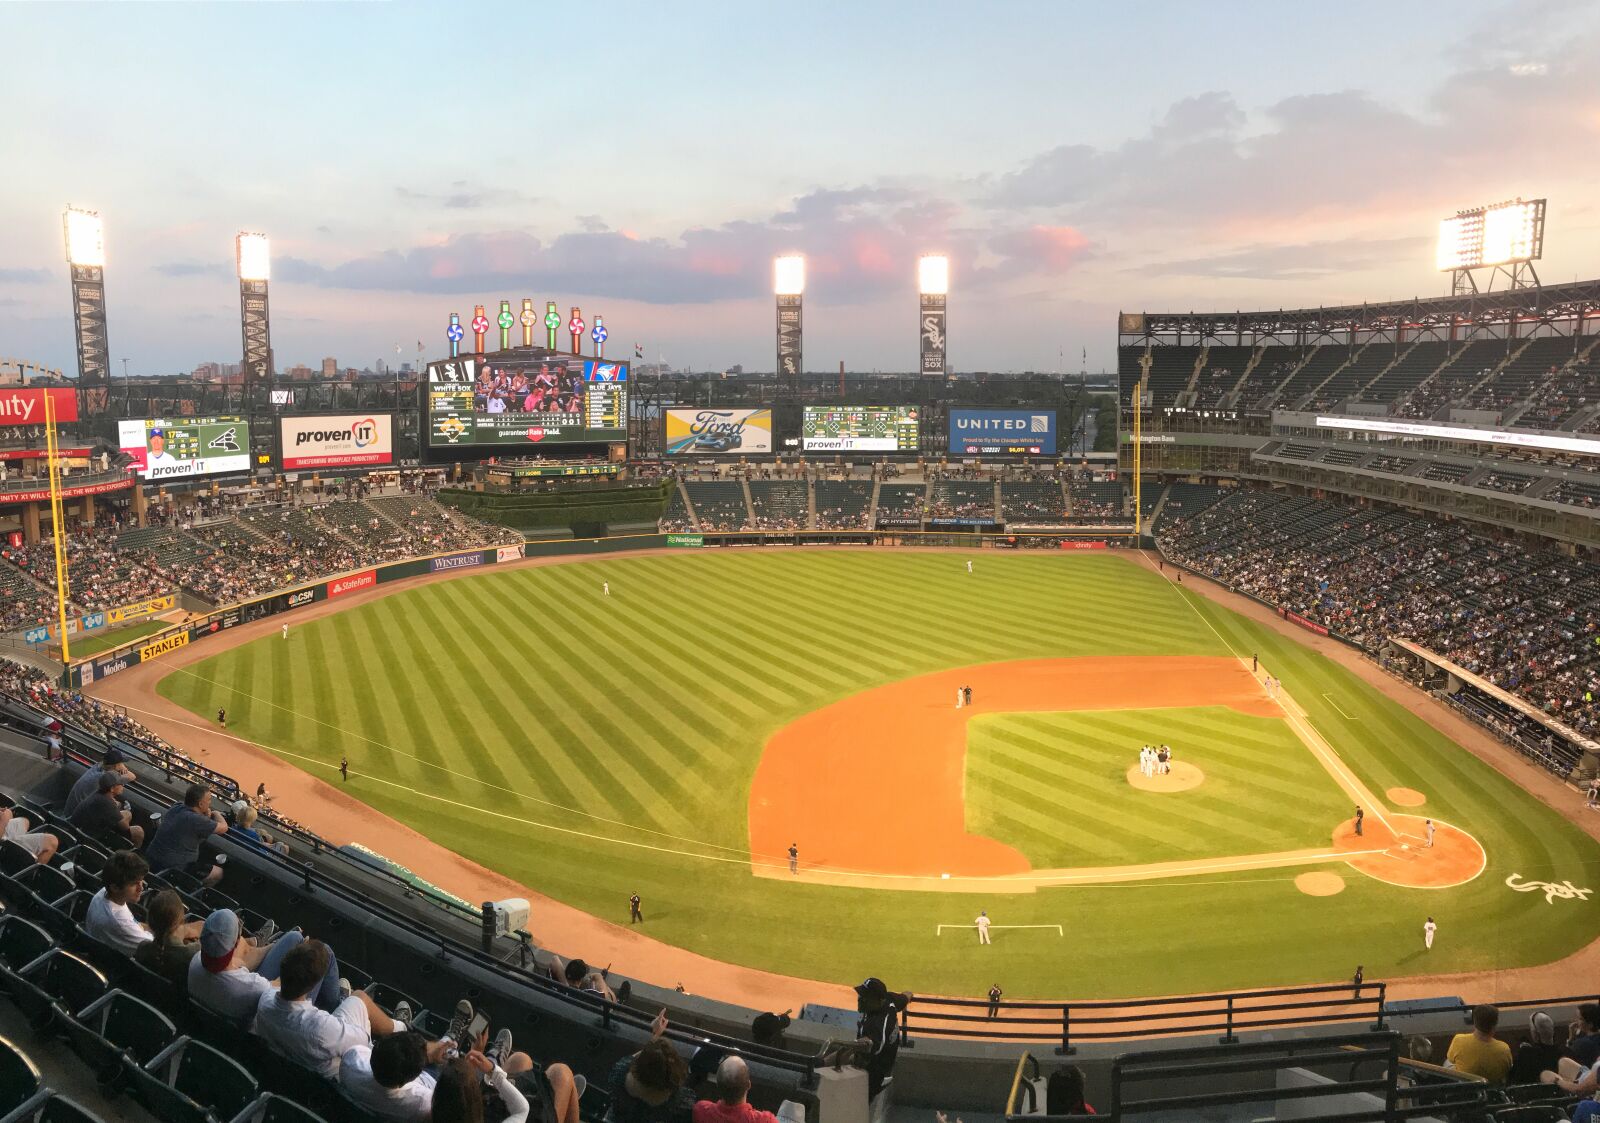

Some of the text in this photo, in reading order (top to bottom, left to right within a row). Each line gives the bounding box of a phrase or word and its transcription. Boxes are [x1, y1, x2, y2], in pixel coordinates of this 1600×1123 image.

[690, 411, 747, 434] Ford
[958, 419, 1026, 430] UNITED
[296, 427, 371, 446] proven IT
[807, 440, 841, 449] proven
[152, 462, 204, 477] proven IT
[47, 490, 72, 498] CANGE
[434, 555, 480, 568] WINTRUST
[298, 590, 314, 602] CSN
[120, 606, 138, 614] Vienna
[144, 634, 186, 659] STANLEY
[104, 660, 127, 676] Modelo
